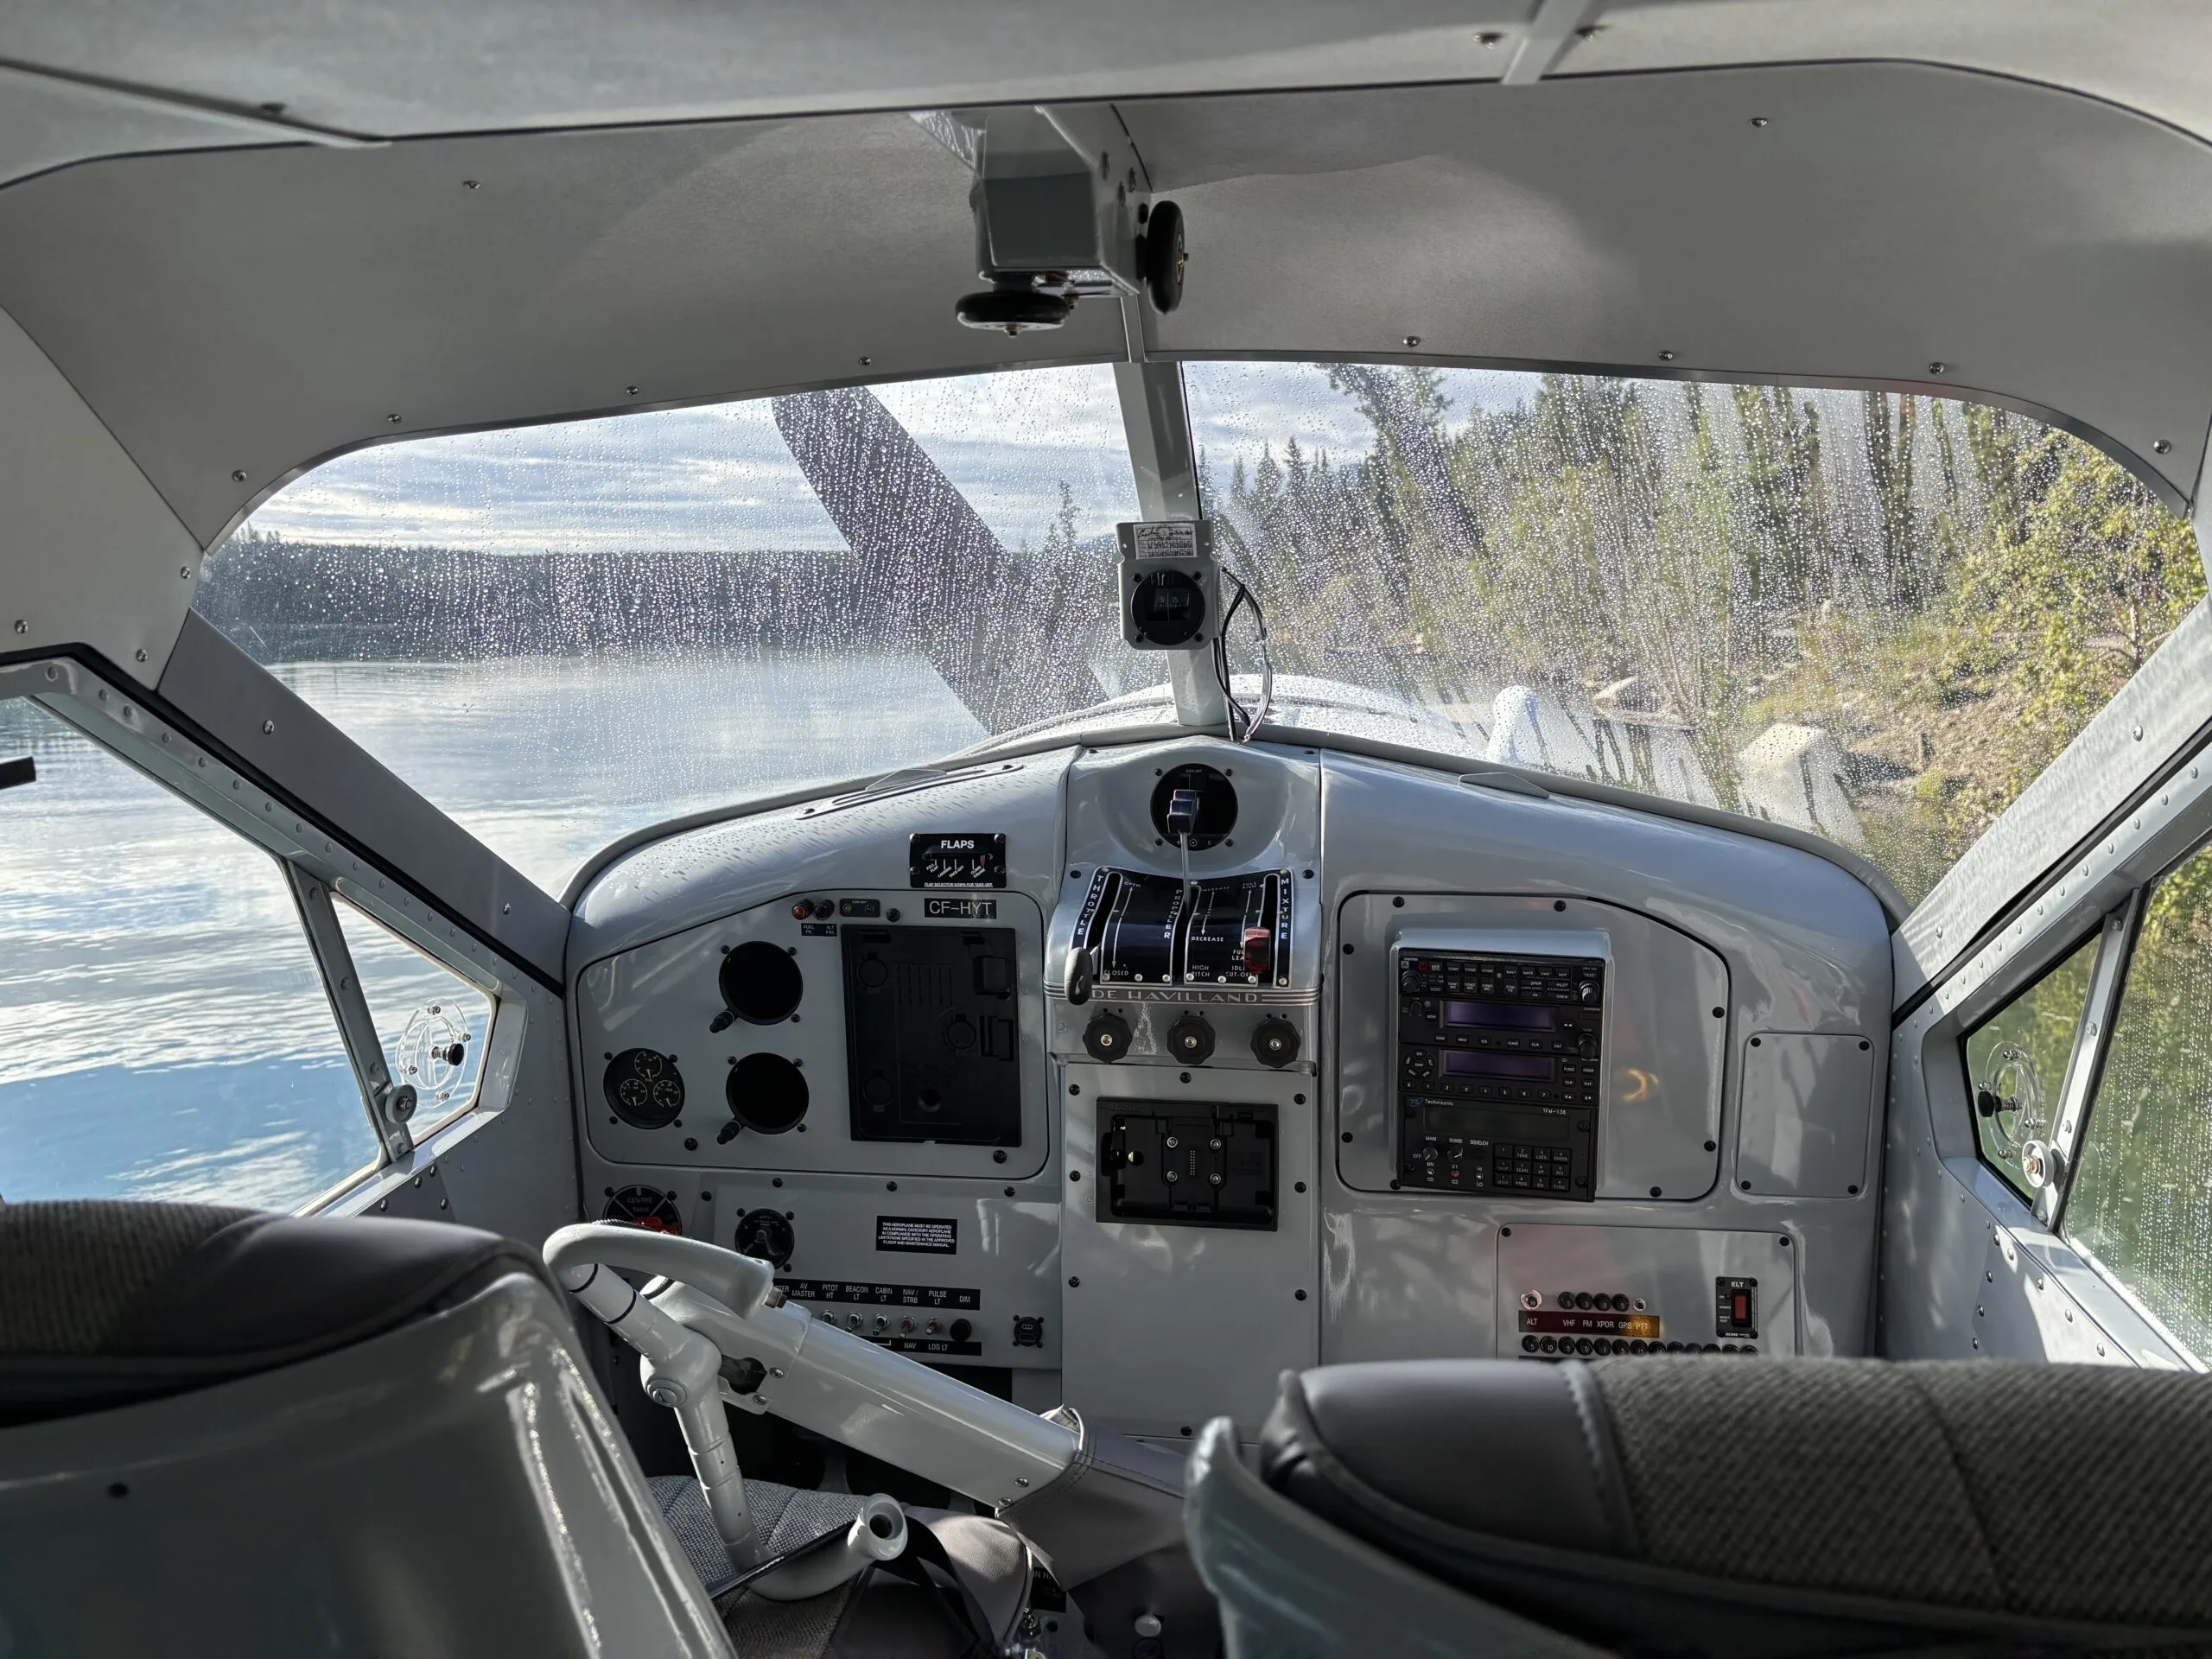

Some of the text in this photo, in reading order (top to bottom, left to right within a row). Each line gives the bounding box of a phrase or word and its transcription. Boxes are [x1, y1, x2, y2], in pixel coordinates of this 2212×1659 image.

[940, 840, 975, 849] FLAPS
[937, 866, 952, 878] LANDING
[948, 865, 964, 878] TAKE-OFF
[929, 900, 992, 915] CF-HYT
[1077, 875, 1104, 935] THROTTLE
[1281, 878, 1290, 940] MIXTURE
[1163, 889, 1183, 939] PROPELLER
[1091, 989, 1257, 1002] DE HAVILLAND
[822, 1284, 838, 1293] PITOT
[845, 1285, 868, 1294] BEACON
[874, 1287, 893, 1295] CABIN
[791, 1289, 816, 1298] MASTER
[928, 1290, 947, 1299] PULSE
[1618, 1321, 1632, 1330] GPS
[904, 1342, 916, 1351] NAV
